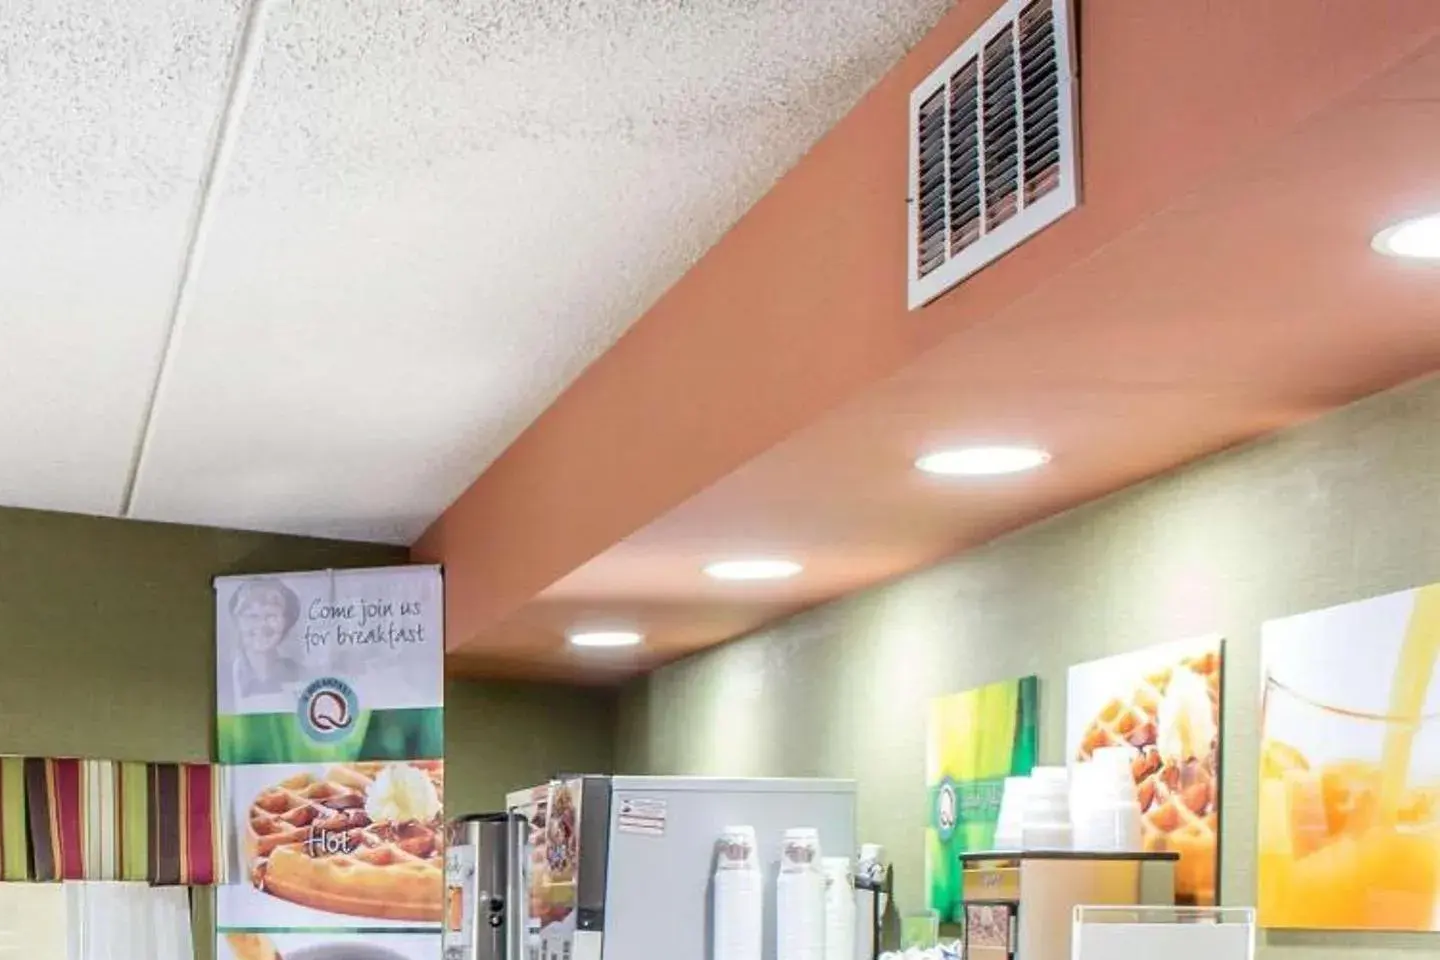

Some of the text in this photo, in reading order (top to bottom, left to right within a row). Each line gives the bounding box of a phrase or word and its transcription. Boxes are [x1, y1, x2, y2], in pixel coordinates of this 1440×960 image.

[308, 598, 421, 626] Come join us
[304, 624, 425, 653] for breakfast
[310, 690, 352, 729] Q
[304, 829, 351, 858] Hot
